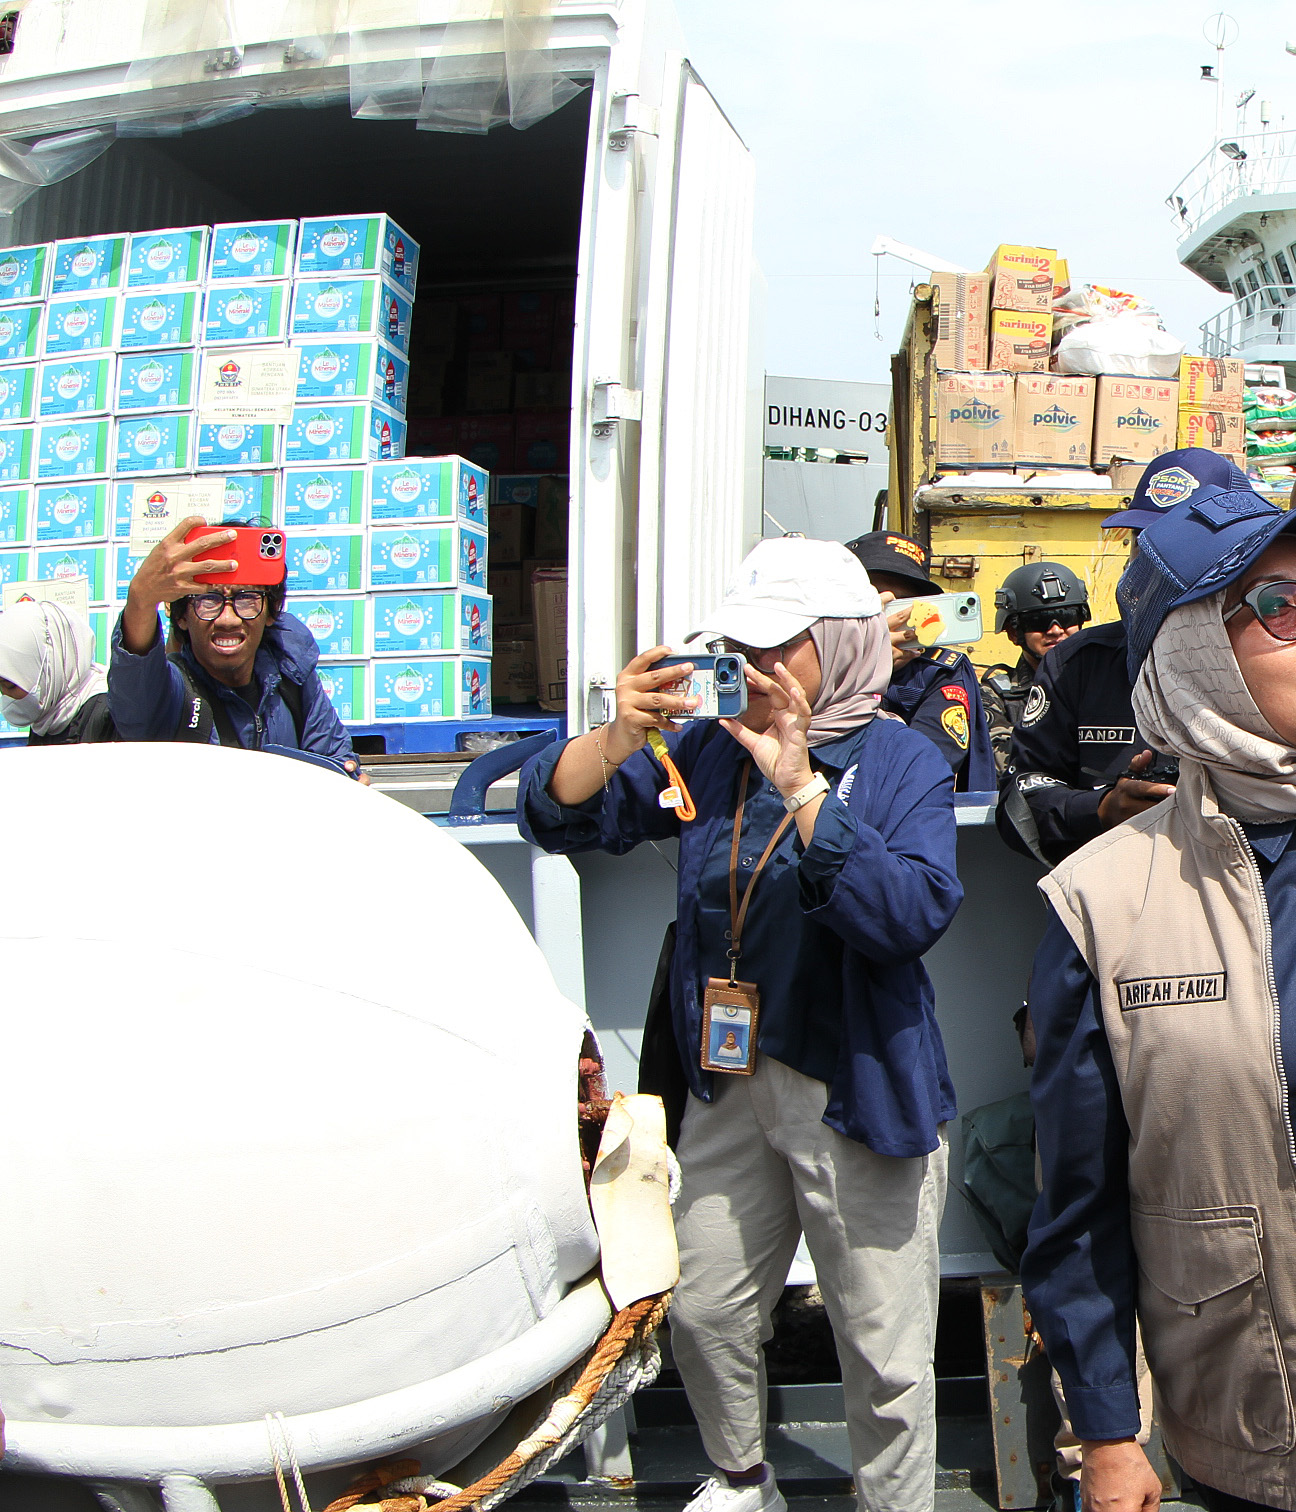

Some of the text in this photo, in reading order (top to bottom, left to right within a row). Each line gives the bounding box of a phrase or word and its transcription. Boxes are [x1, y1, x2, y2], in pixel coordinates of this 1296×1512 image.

[1004, 254, 1050, 272] sarimi 2
[1000, 320, 1046, 337] sarimi 2
[1033, 362, 1044, 370] 24
[1190, 361, 1204, 372] 2
[1230, 363, 1236, 373] 24
[769, 406, 887, 432] DIHANG-03
[950, 406, 1000, 423] polvic
[1034, 410, 1077, 426] polvic
[1118, 415, 1159, 428] polvic
[1229, 417, 1236, 428] 24
[1186, 415, 1203, 448] rimi 2
[1152, 475, 1197, 486] PSDKP
[1156, 483, 1184, 491] PANTANG
[944, 653, 957, 665] KKP
[189, 698, 201, 728] torch
[1125, 977, 1218, 1005] ARIFAH FAUZI
